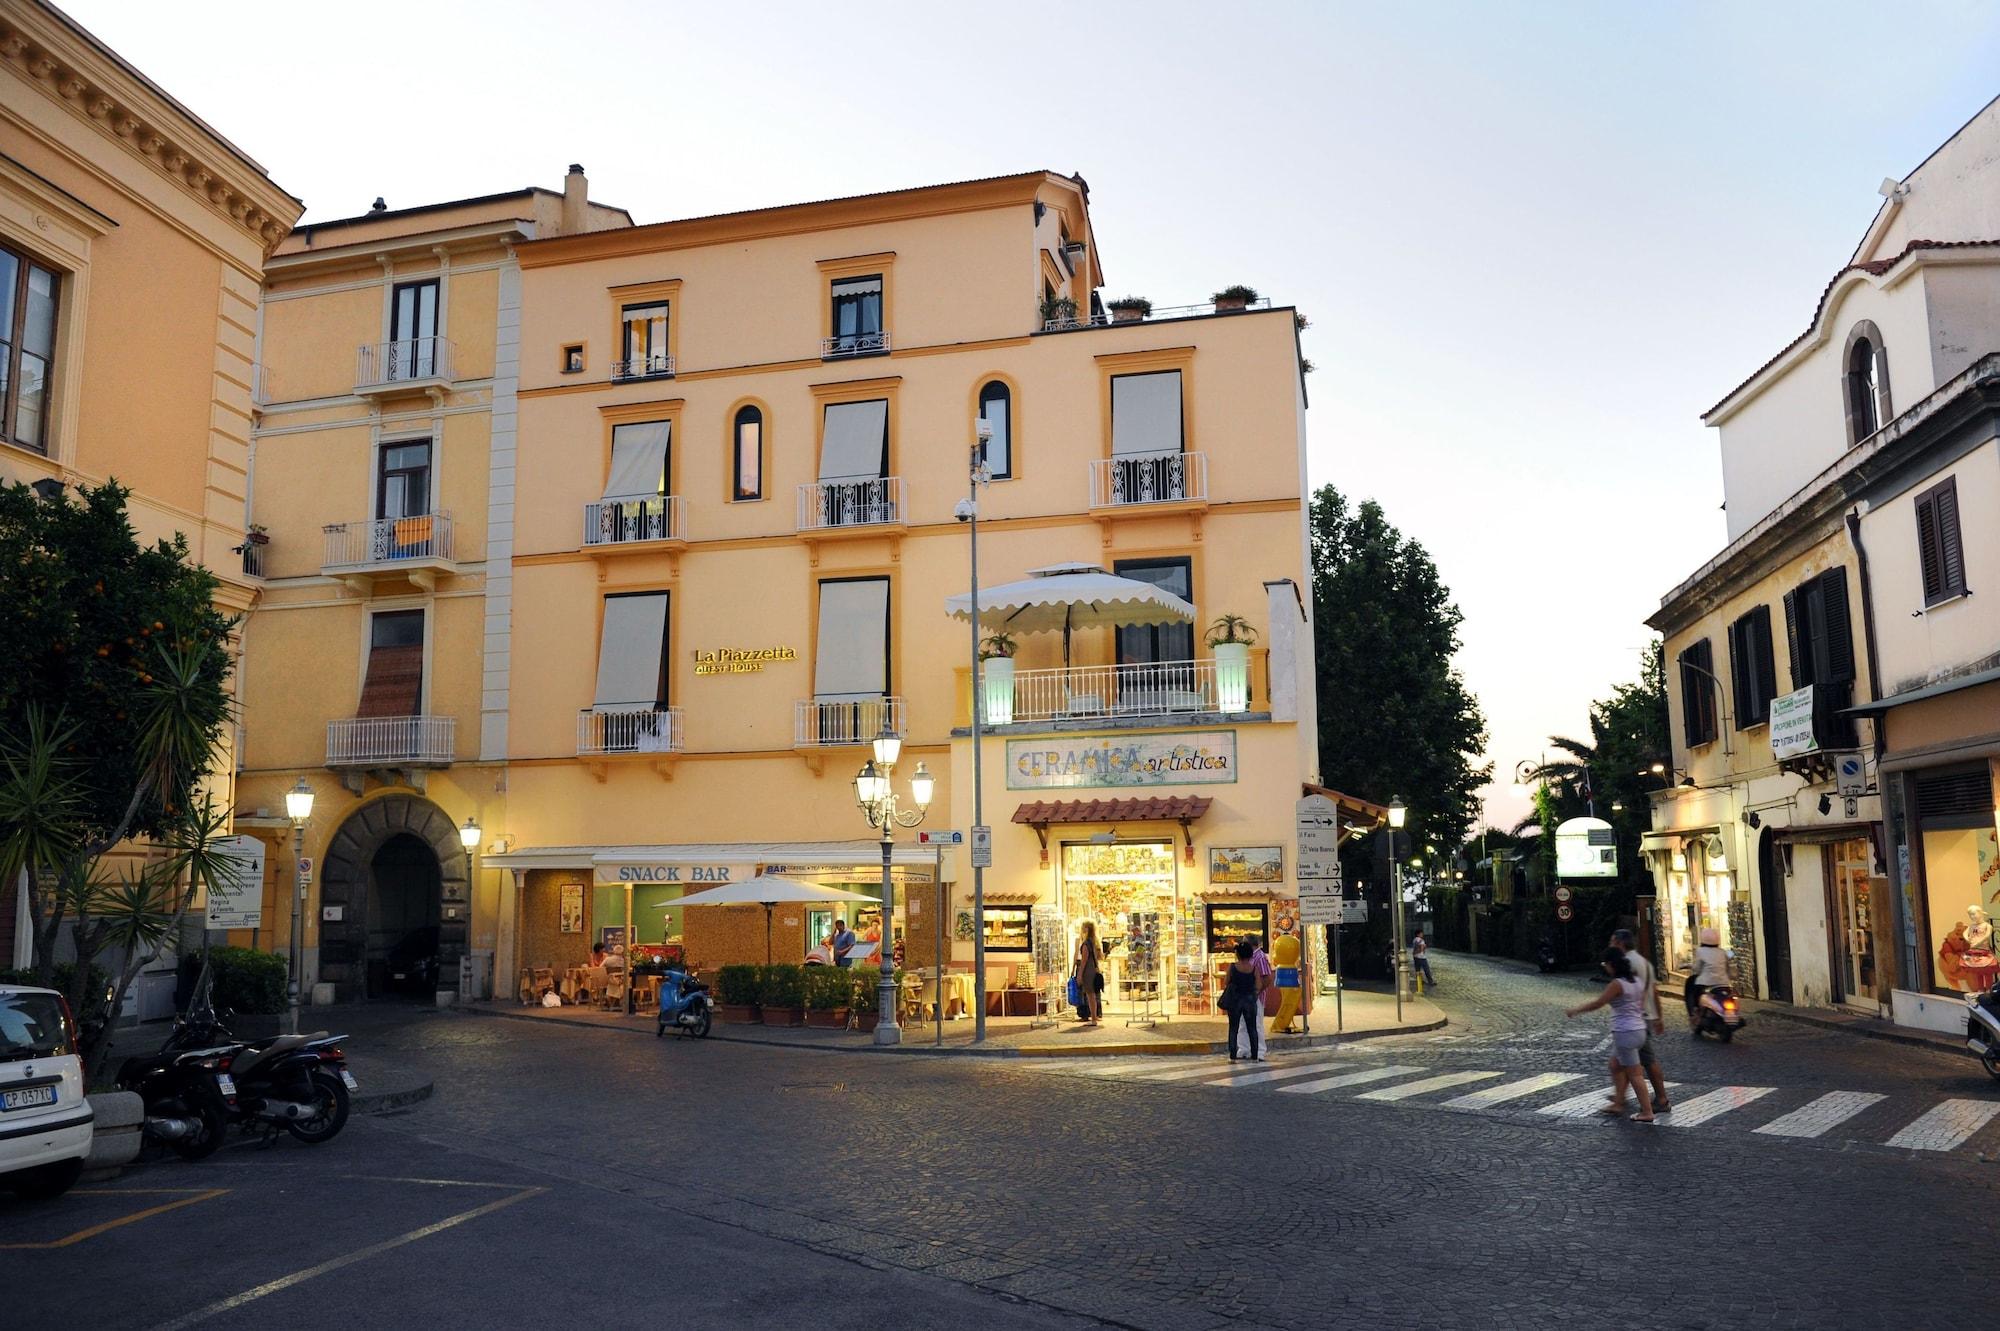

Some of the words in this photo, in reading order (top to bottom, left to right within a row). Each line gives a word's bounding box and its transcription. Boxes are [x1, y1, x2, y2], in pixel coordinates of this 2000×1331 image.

[695, 648, 714, 662] La
[718, 645, 796, 662] Piazzetta
[695, 664, 725, 674] GUEST
[728, 663, 763, 673] HOUSE
[1017, 746, 1143, 777] CERAMICA
[1143, 748, 1228, 773] artistica
[619, 866, 681, 881] SNACK
[691, 866, 730, 881] BAR
[767, 865, 787, 873] BAR
[1560, 908, 1569, 917] 30
[6, 1092, 18, 1107] CP
